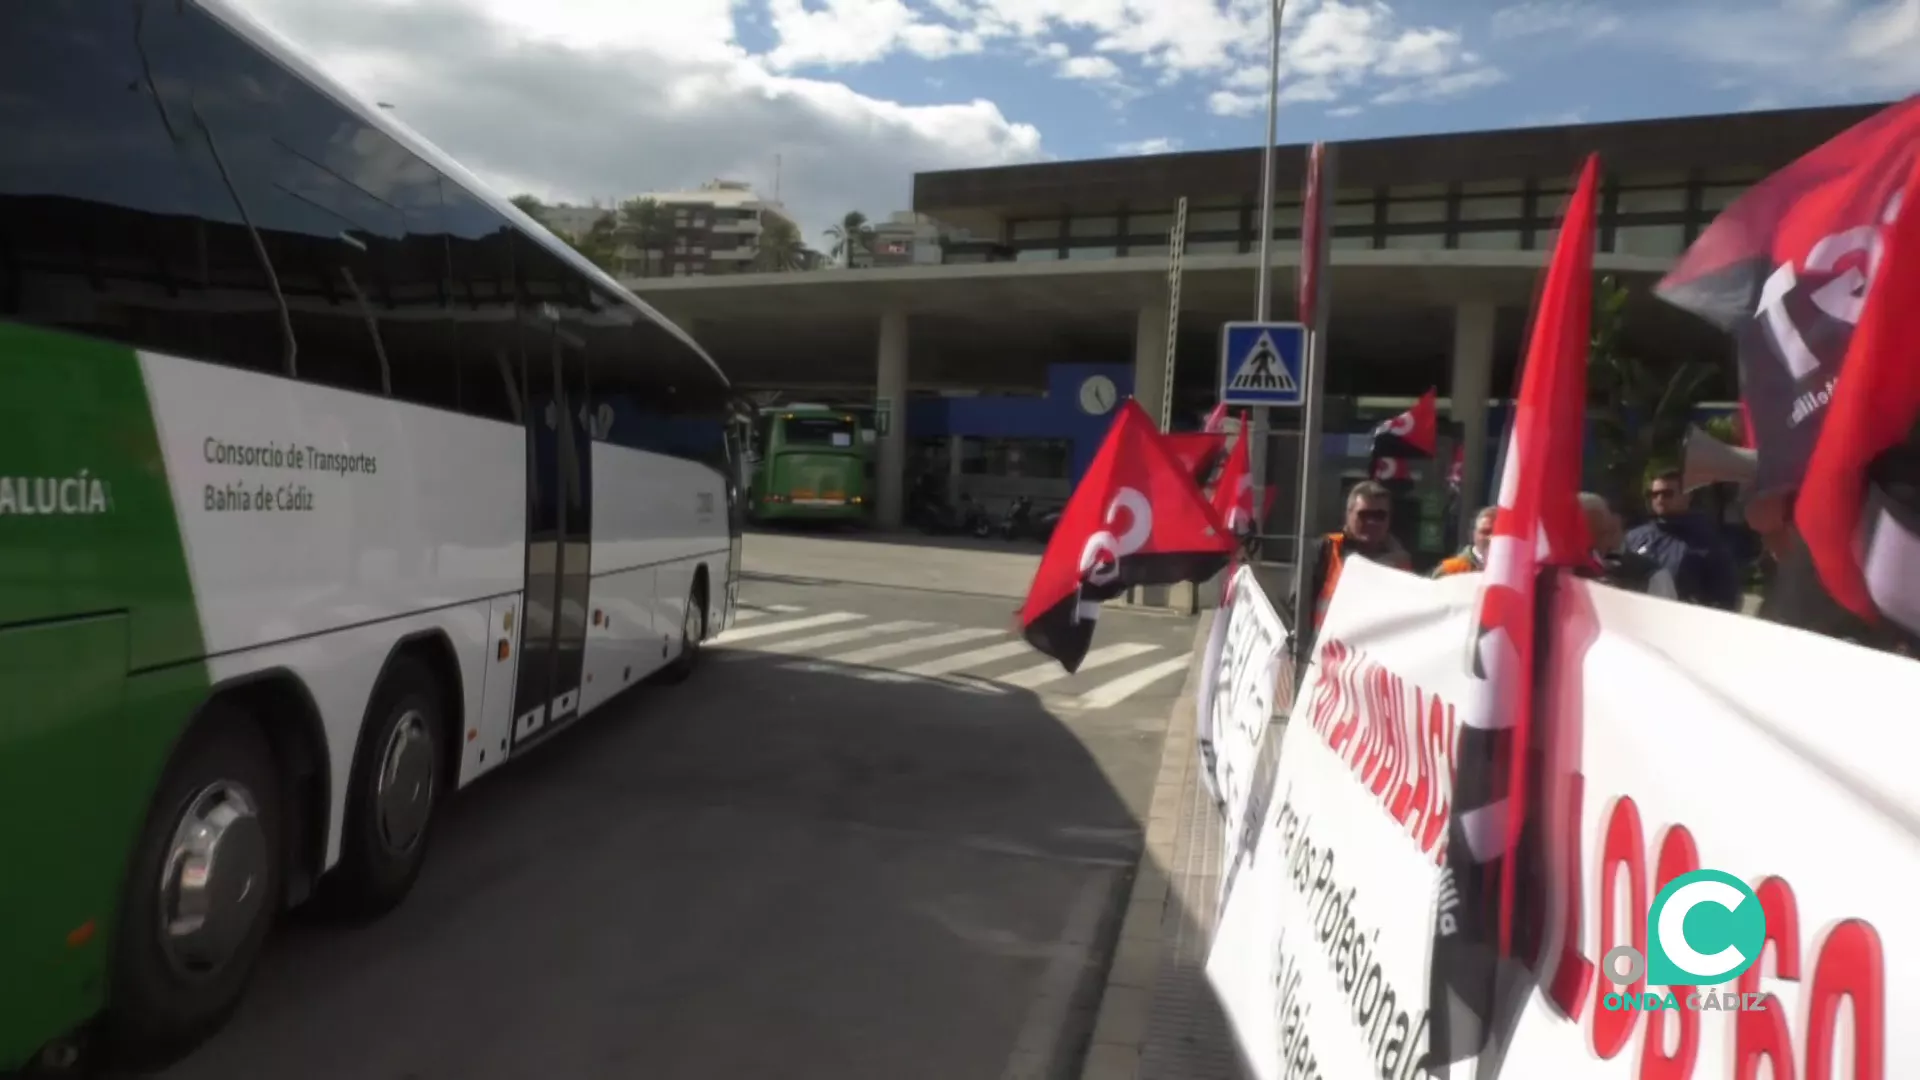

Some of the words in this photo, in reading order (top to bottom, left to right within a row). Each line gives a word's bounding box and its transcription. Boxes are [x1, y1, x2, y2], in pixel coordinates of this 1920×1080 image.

[203, 436, 283, 468] Consorcio
[286, 443, 303, 469] de
[306, 446, 377, 477] Transportes
[0, 468, 106, 513] ALUCÍA
[204, 479, 251, 511] Bahía
[254, 484, 274, 511] de
[276, 482, 314, 511] Cádiz
